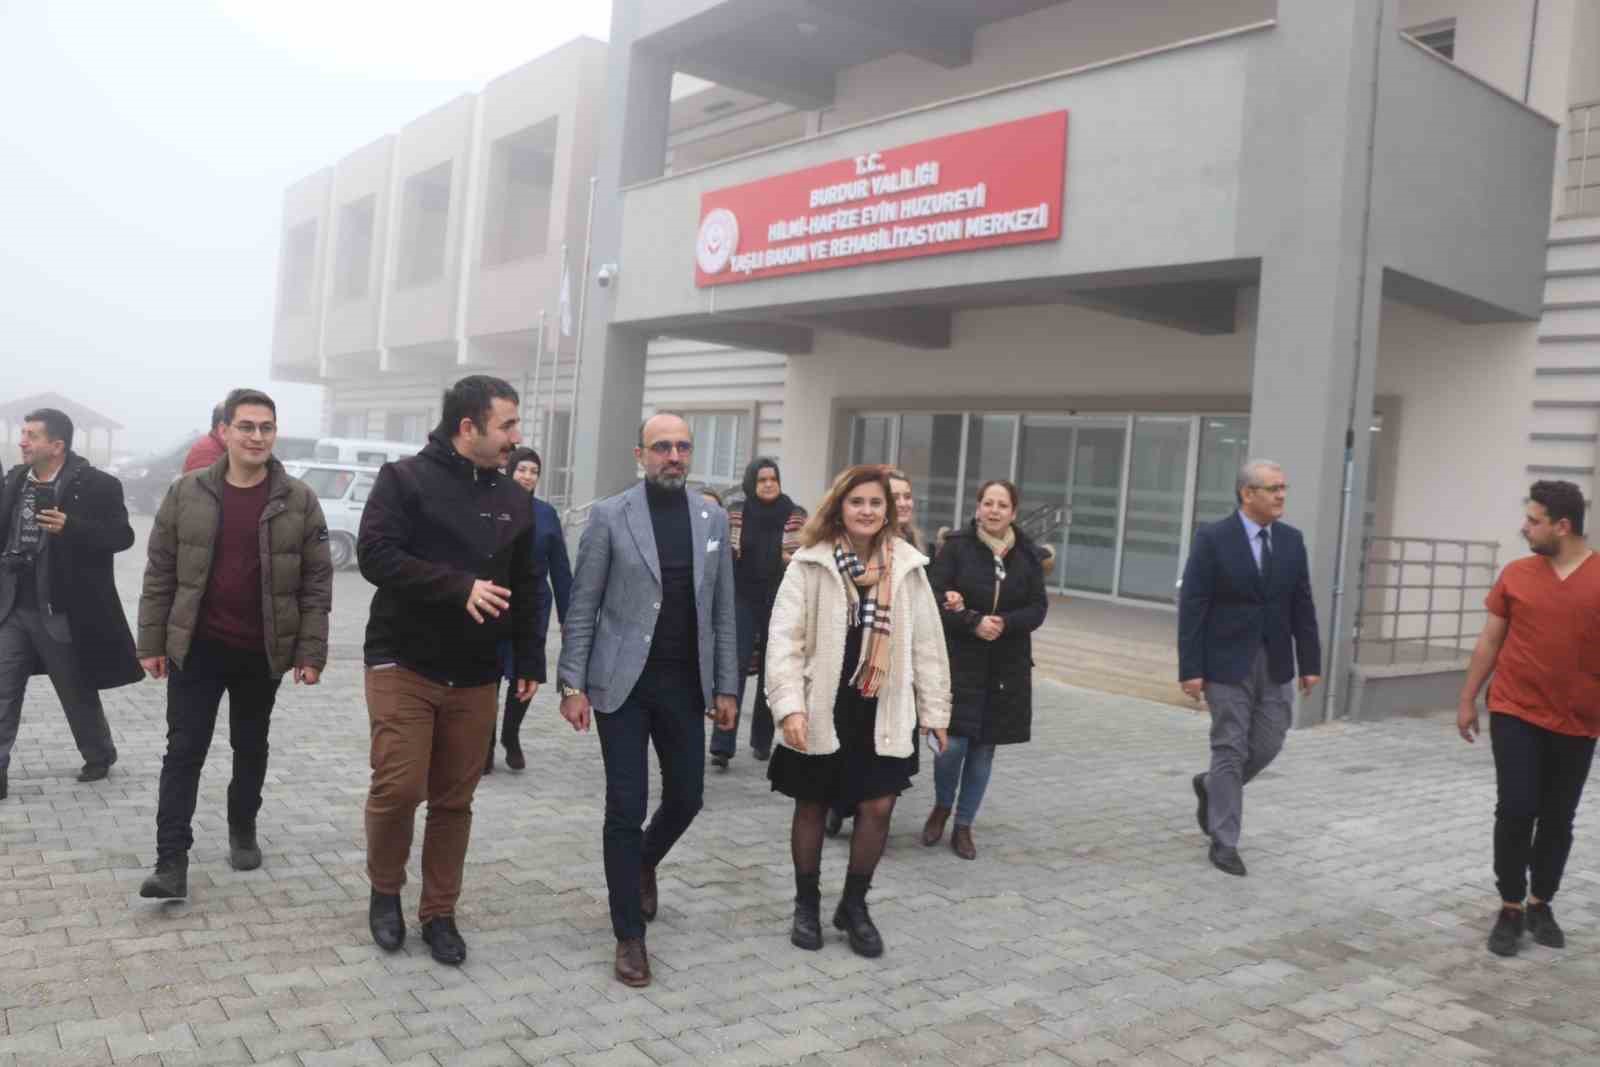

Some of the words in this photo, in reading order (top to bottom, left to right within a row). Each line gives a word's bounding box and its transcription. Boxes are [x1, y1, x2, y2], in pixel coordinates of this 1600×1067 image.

[856, 153, 886, 175] T.C.
[809, 178, 870, 208] BURDUR
[900, 182, 986, 219] HUZUREVİ
[766, 245, 808, 267] BAKIM
[809, 240, 828, 260] VE
[965, 202, 1048, 238] MERKEZİ
